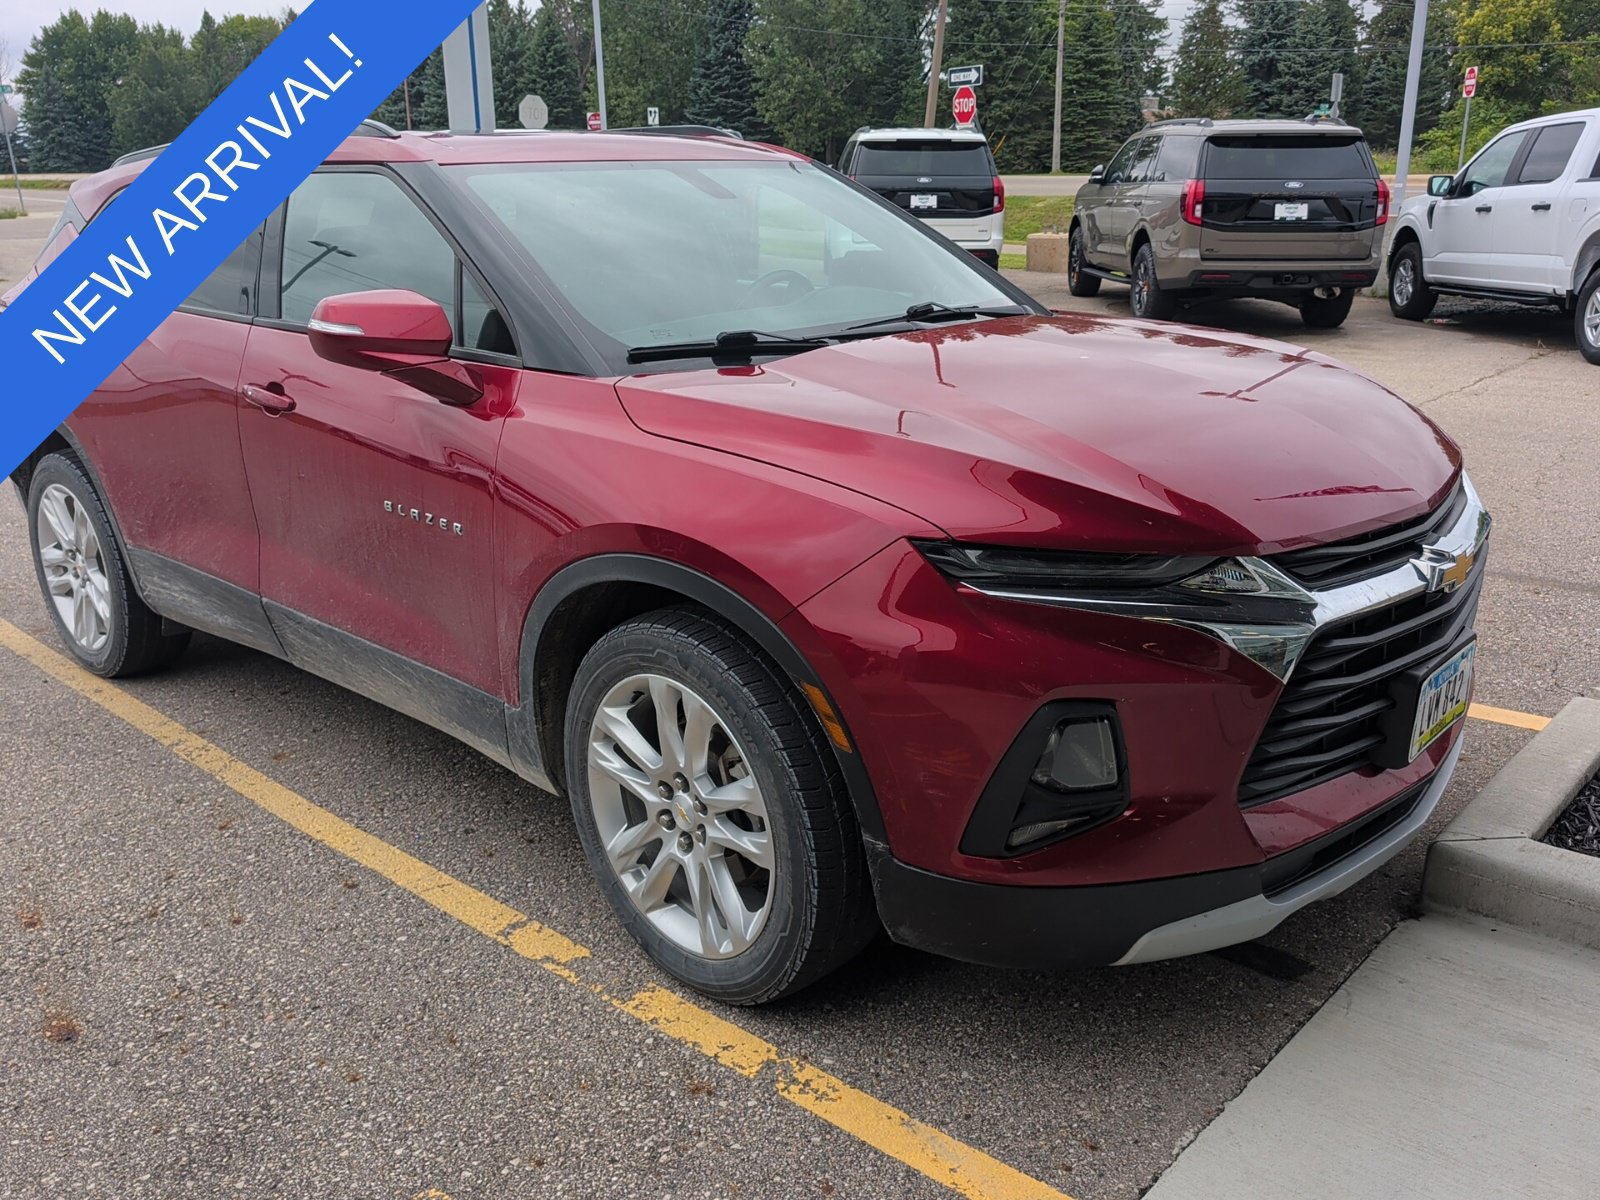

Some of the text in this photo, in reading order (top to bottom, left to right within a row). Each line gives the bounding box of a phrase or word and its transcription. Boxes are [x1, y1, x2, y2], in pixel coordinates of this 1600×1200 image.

[954, 98, 974, 113] STOP
[383, 500, 462, 536] BLAZER
[1442, 669, 1465, 716] 842
